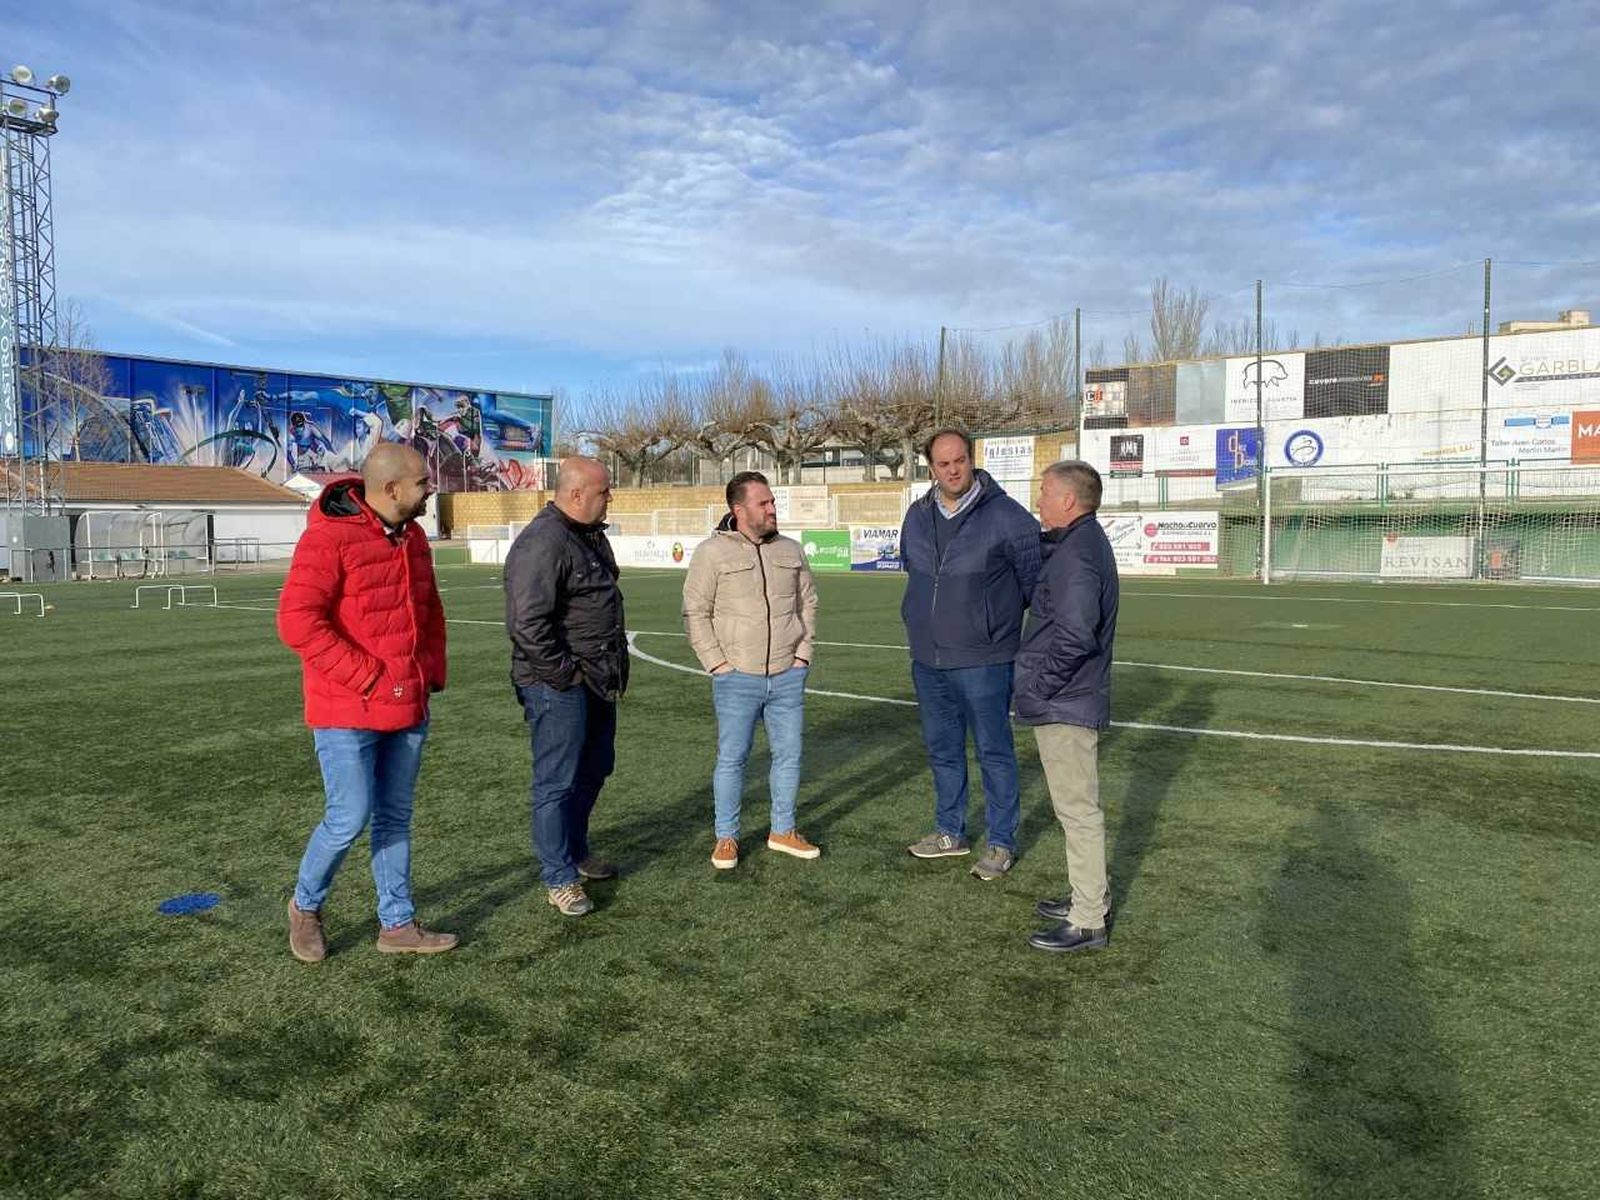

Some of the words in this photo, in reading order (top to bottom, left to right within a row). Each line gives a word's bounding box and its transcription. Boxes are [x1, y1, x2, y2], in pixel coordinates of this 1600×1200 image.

[0, 335, 12, 427] CASTRO
[863, 529, 899, 539] VIAMAR
[1385, 556, 1469, 568] REVISAN
